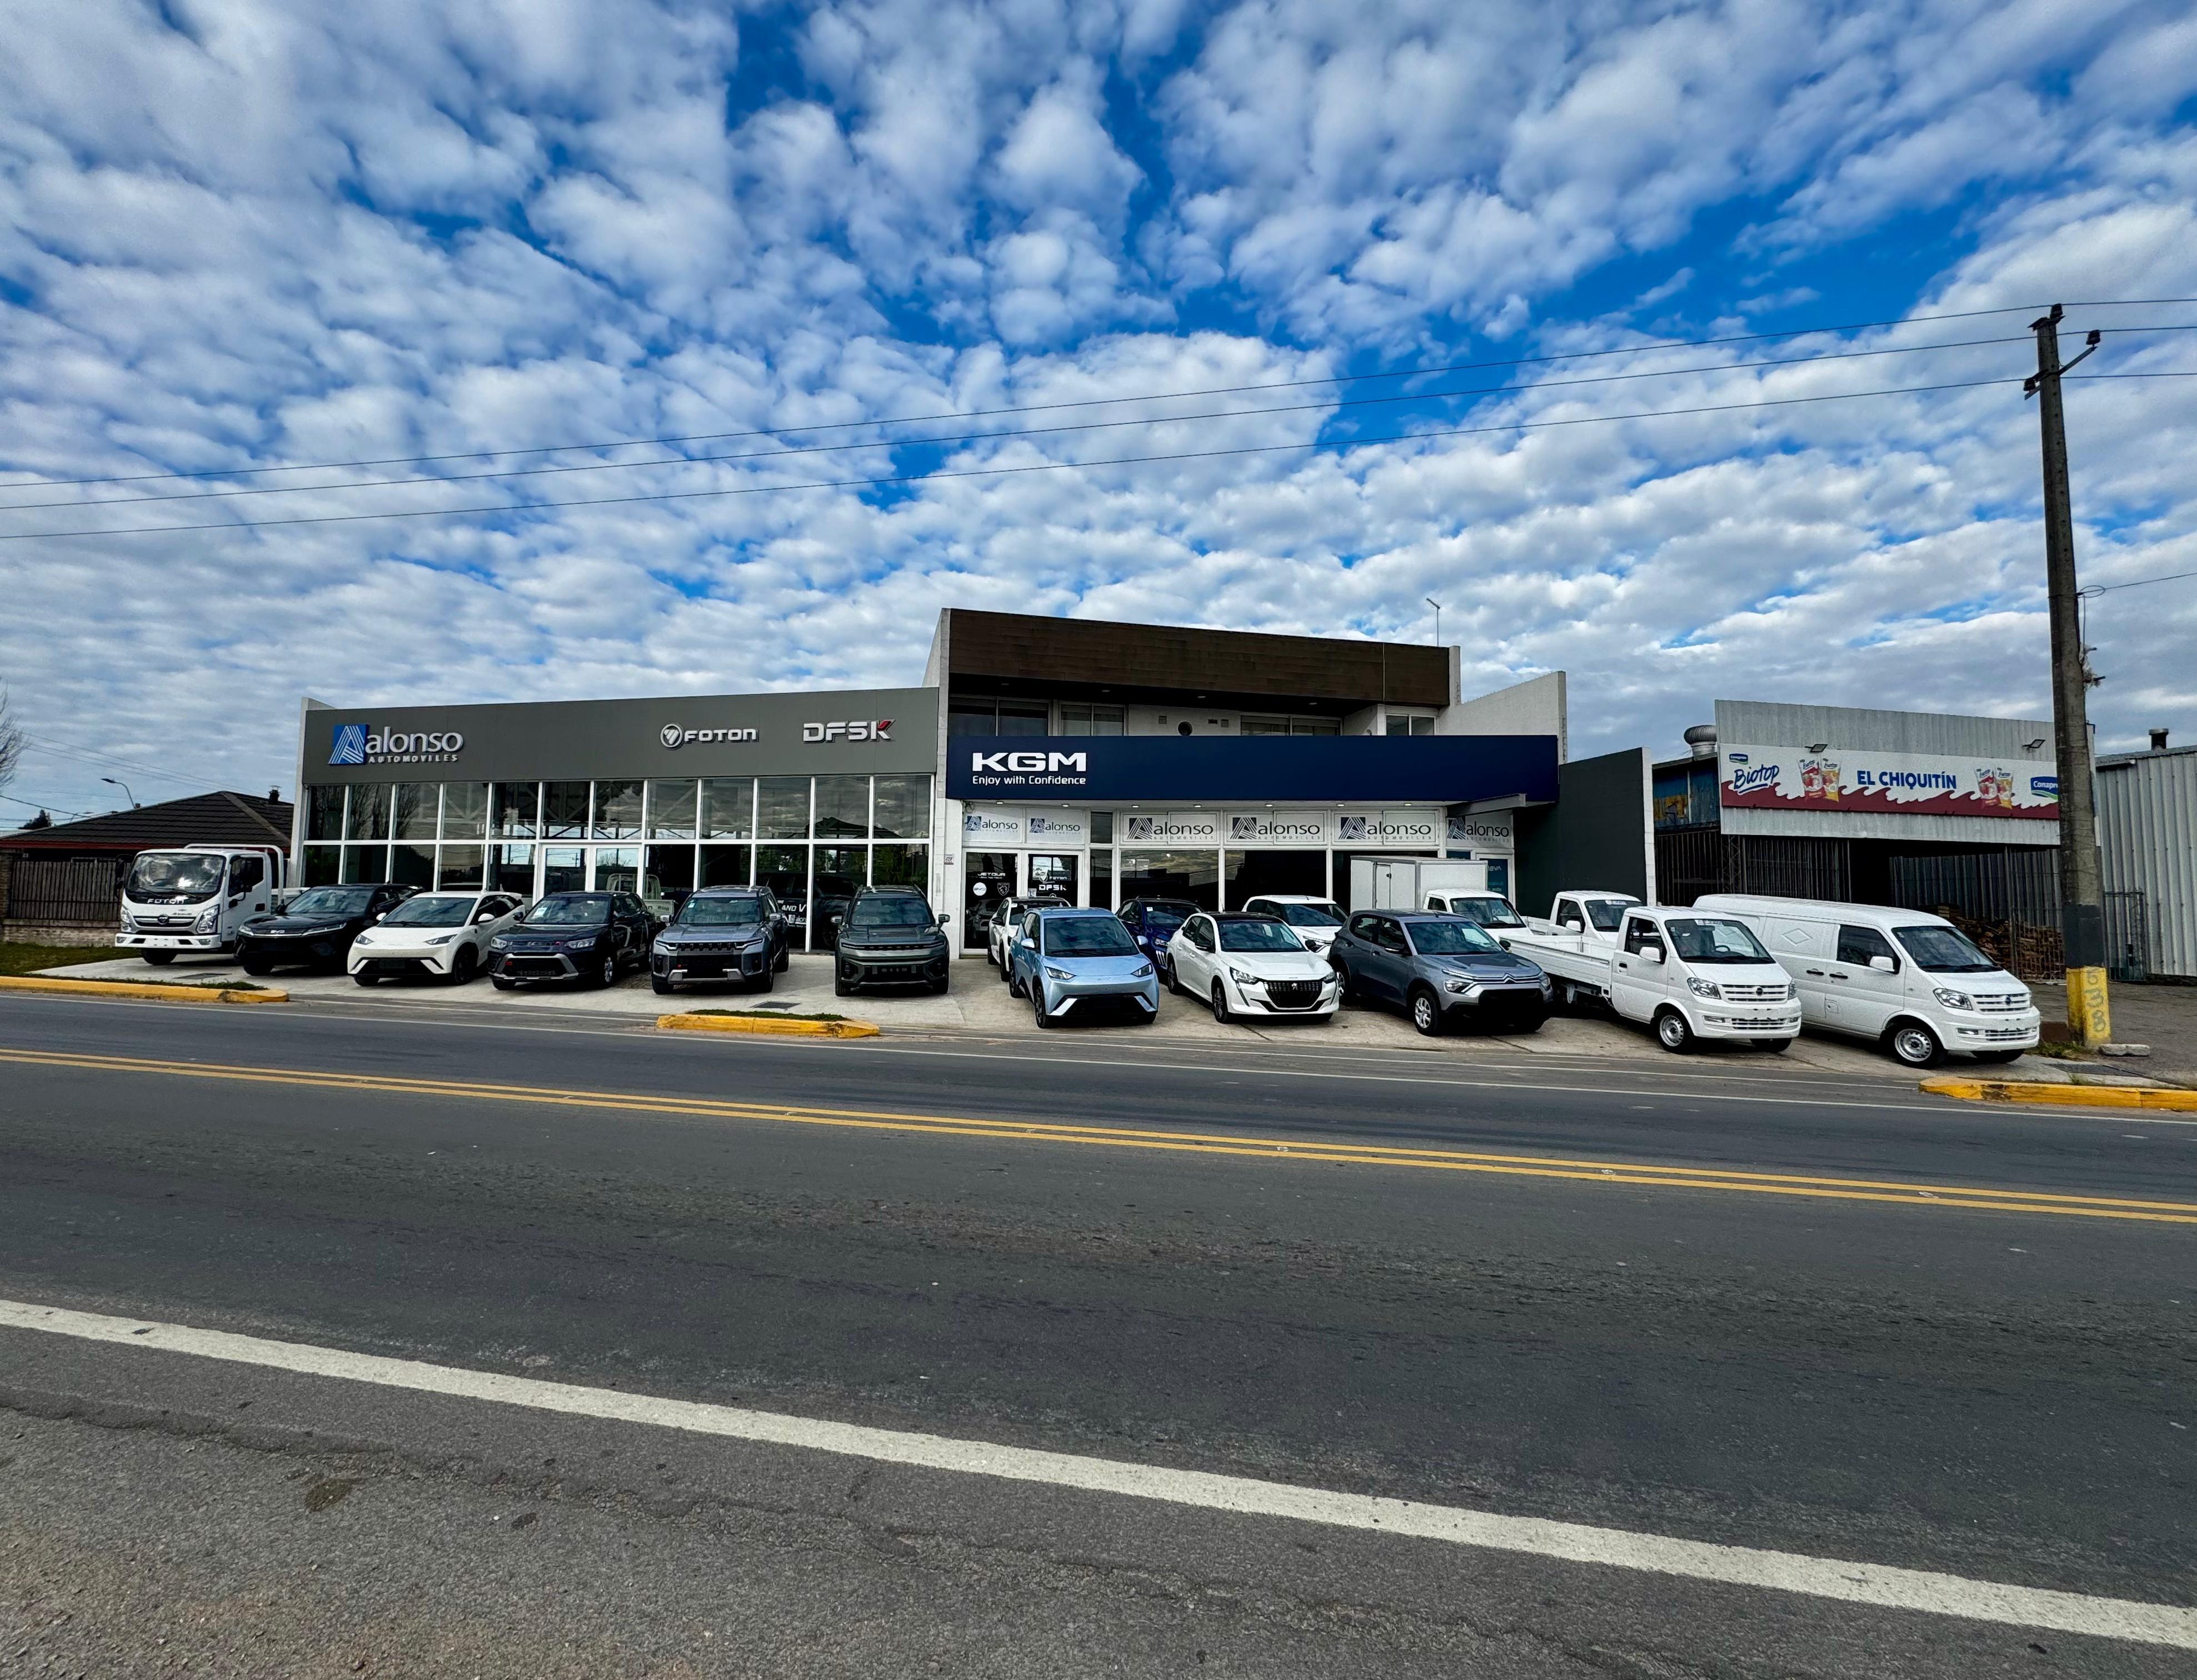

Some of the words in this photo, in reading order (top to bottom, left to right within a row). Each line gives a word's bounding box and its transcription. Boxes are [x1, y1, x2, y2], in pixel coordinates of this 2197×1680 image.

[684, 729, 756, 742] FOTON
[803, 720, 892, 742] DFSK
[365, 727, 463, 753] alonso
[369, 754, 458, 763] AUTOMOVILES
[972, 752, 1086, 771] KGM
[972, 776, 1001, 786] Enjoy
[1003, 776, 1025, 784] with
[1028, 776, 1086, 784] Confidence
[1734, 764, 1780, 789] Biotop
[1857, 770, 1876, 786] EL
[1879, 771, 1957, 789] CHIQUITÍN
[2033, 781, 2058, 789] Conapr
[982, 819, 1018, 829] alonso
[1045, 822, 1080, 831] alonso
[1153, 822, 1214, 835] alonso
[1257, 821, 1320, 834] alonso
[1367, 821, 1431, 834] alonso
[1466, 821, 1509, 837] alonso
